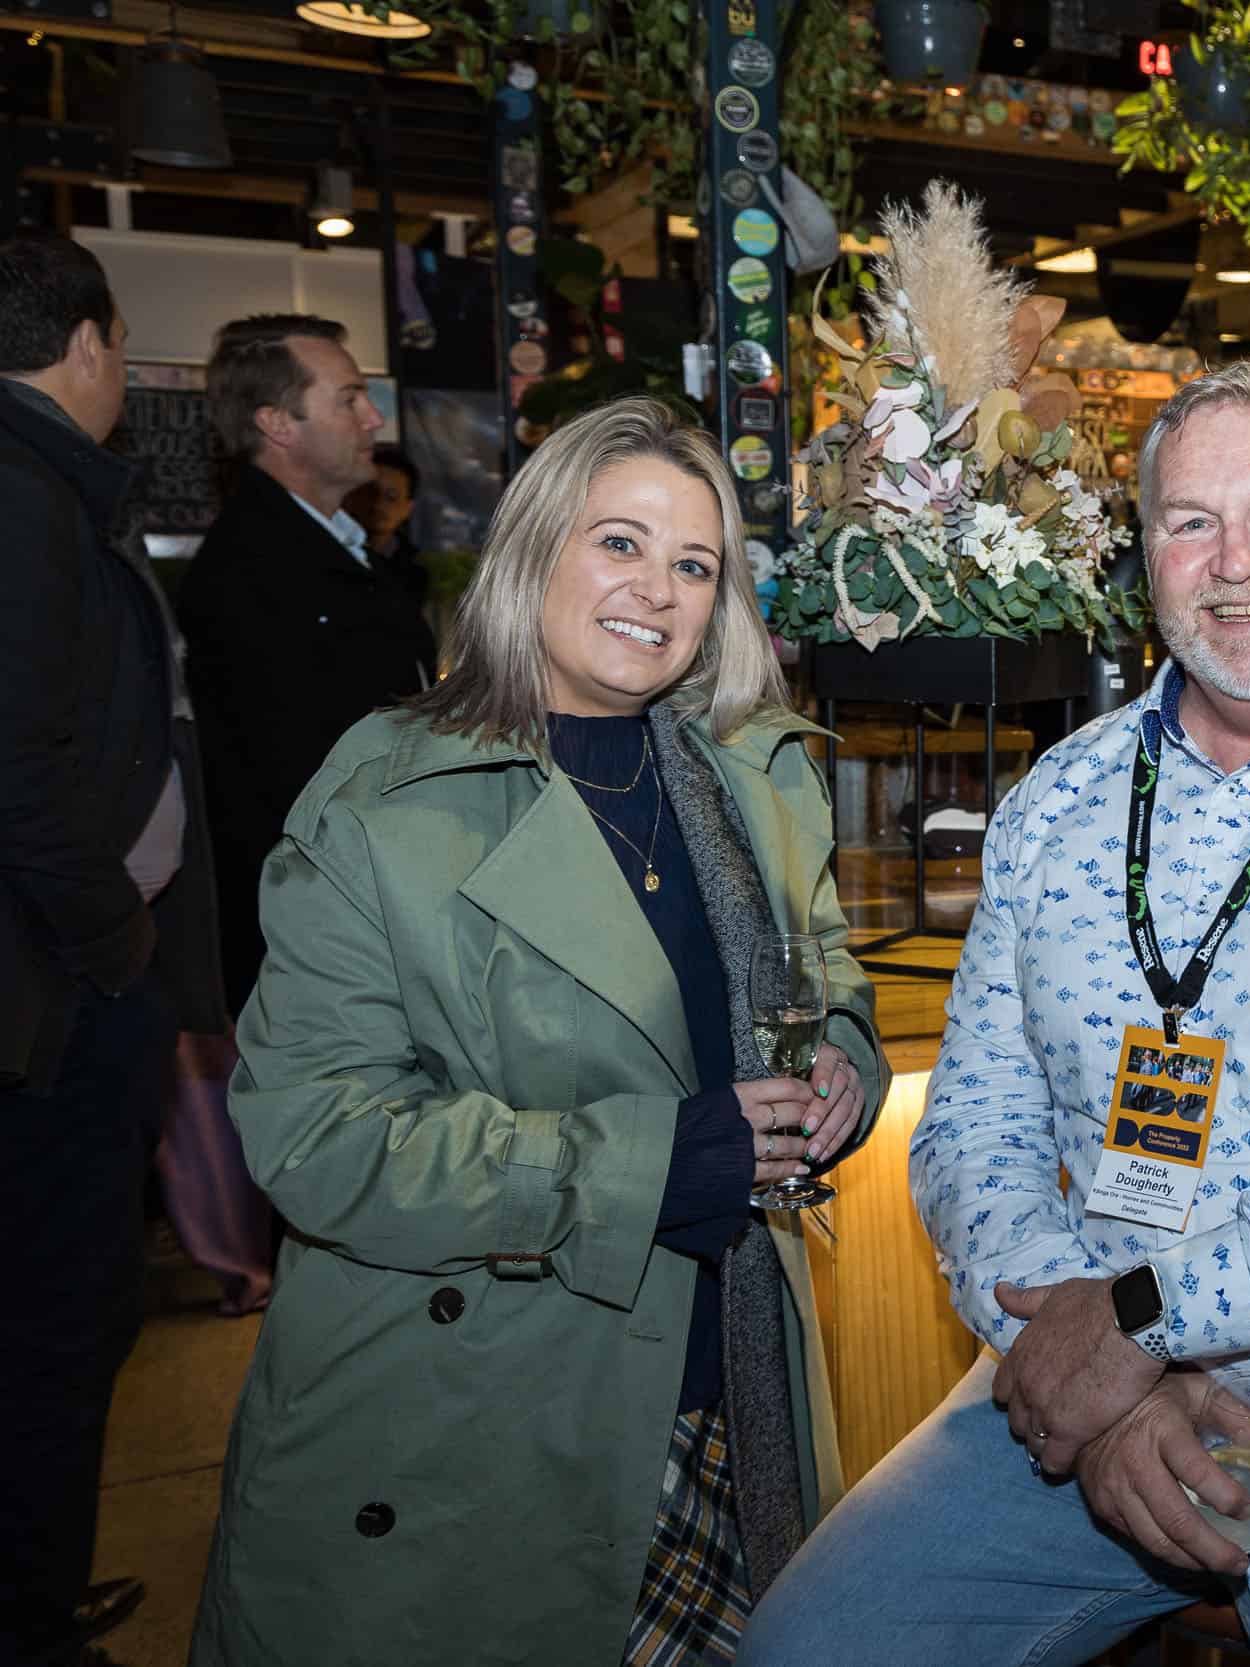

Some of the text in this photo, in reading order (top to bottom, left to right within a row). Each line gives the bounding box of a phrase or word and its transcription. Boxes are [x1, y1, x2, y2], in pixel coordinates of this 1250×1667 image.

[1140, 41, 1172, 75] CA
[1135, 800, 1145, 857] www.resene.com
[1135, 927, 1155, 971] Resene
[1196, 917, 1229, 963] Resene
[1146, 1138, 1176, 1148] Conference
[1148, 1130, 1157, 1138] The
[1129, 1160, 1169, 1179] Patrick
[1115, 1172, 1175, 1197] Dougherty
[1121, 1205, 1148, 1215] Delegate
